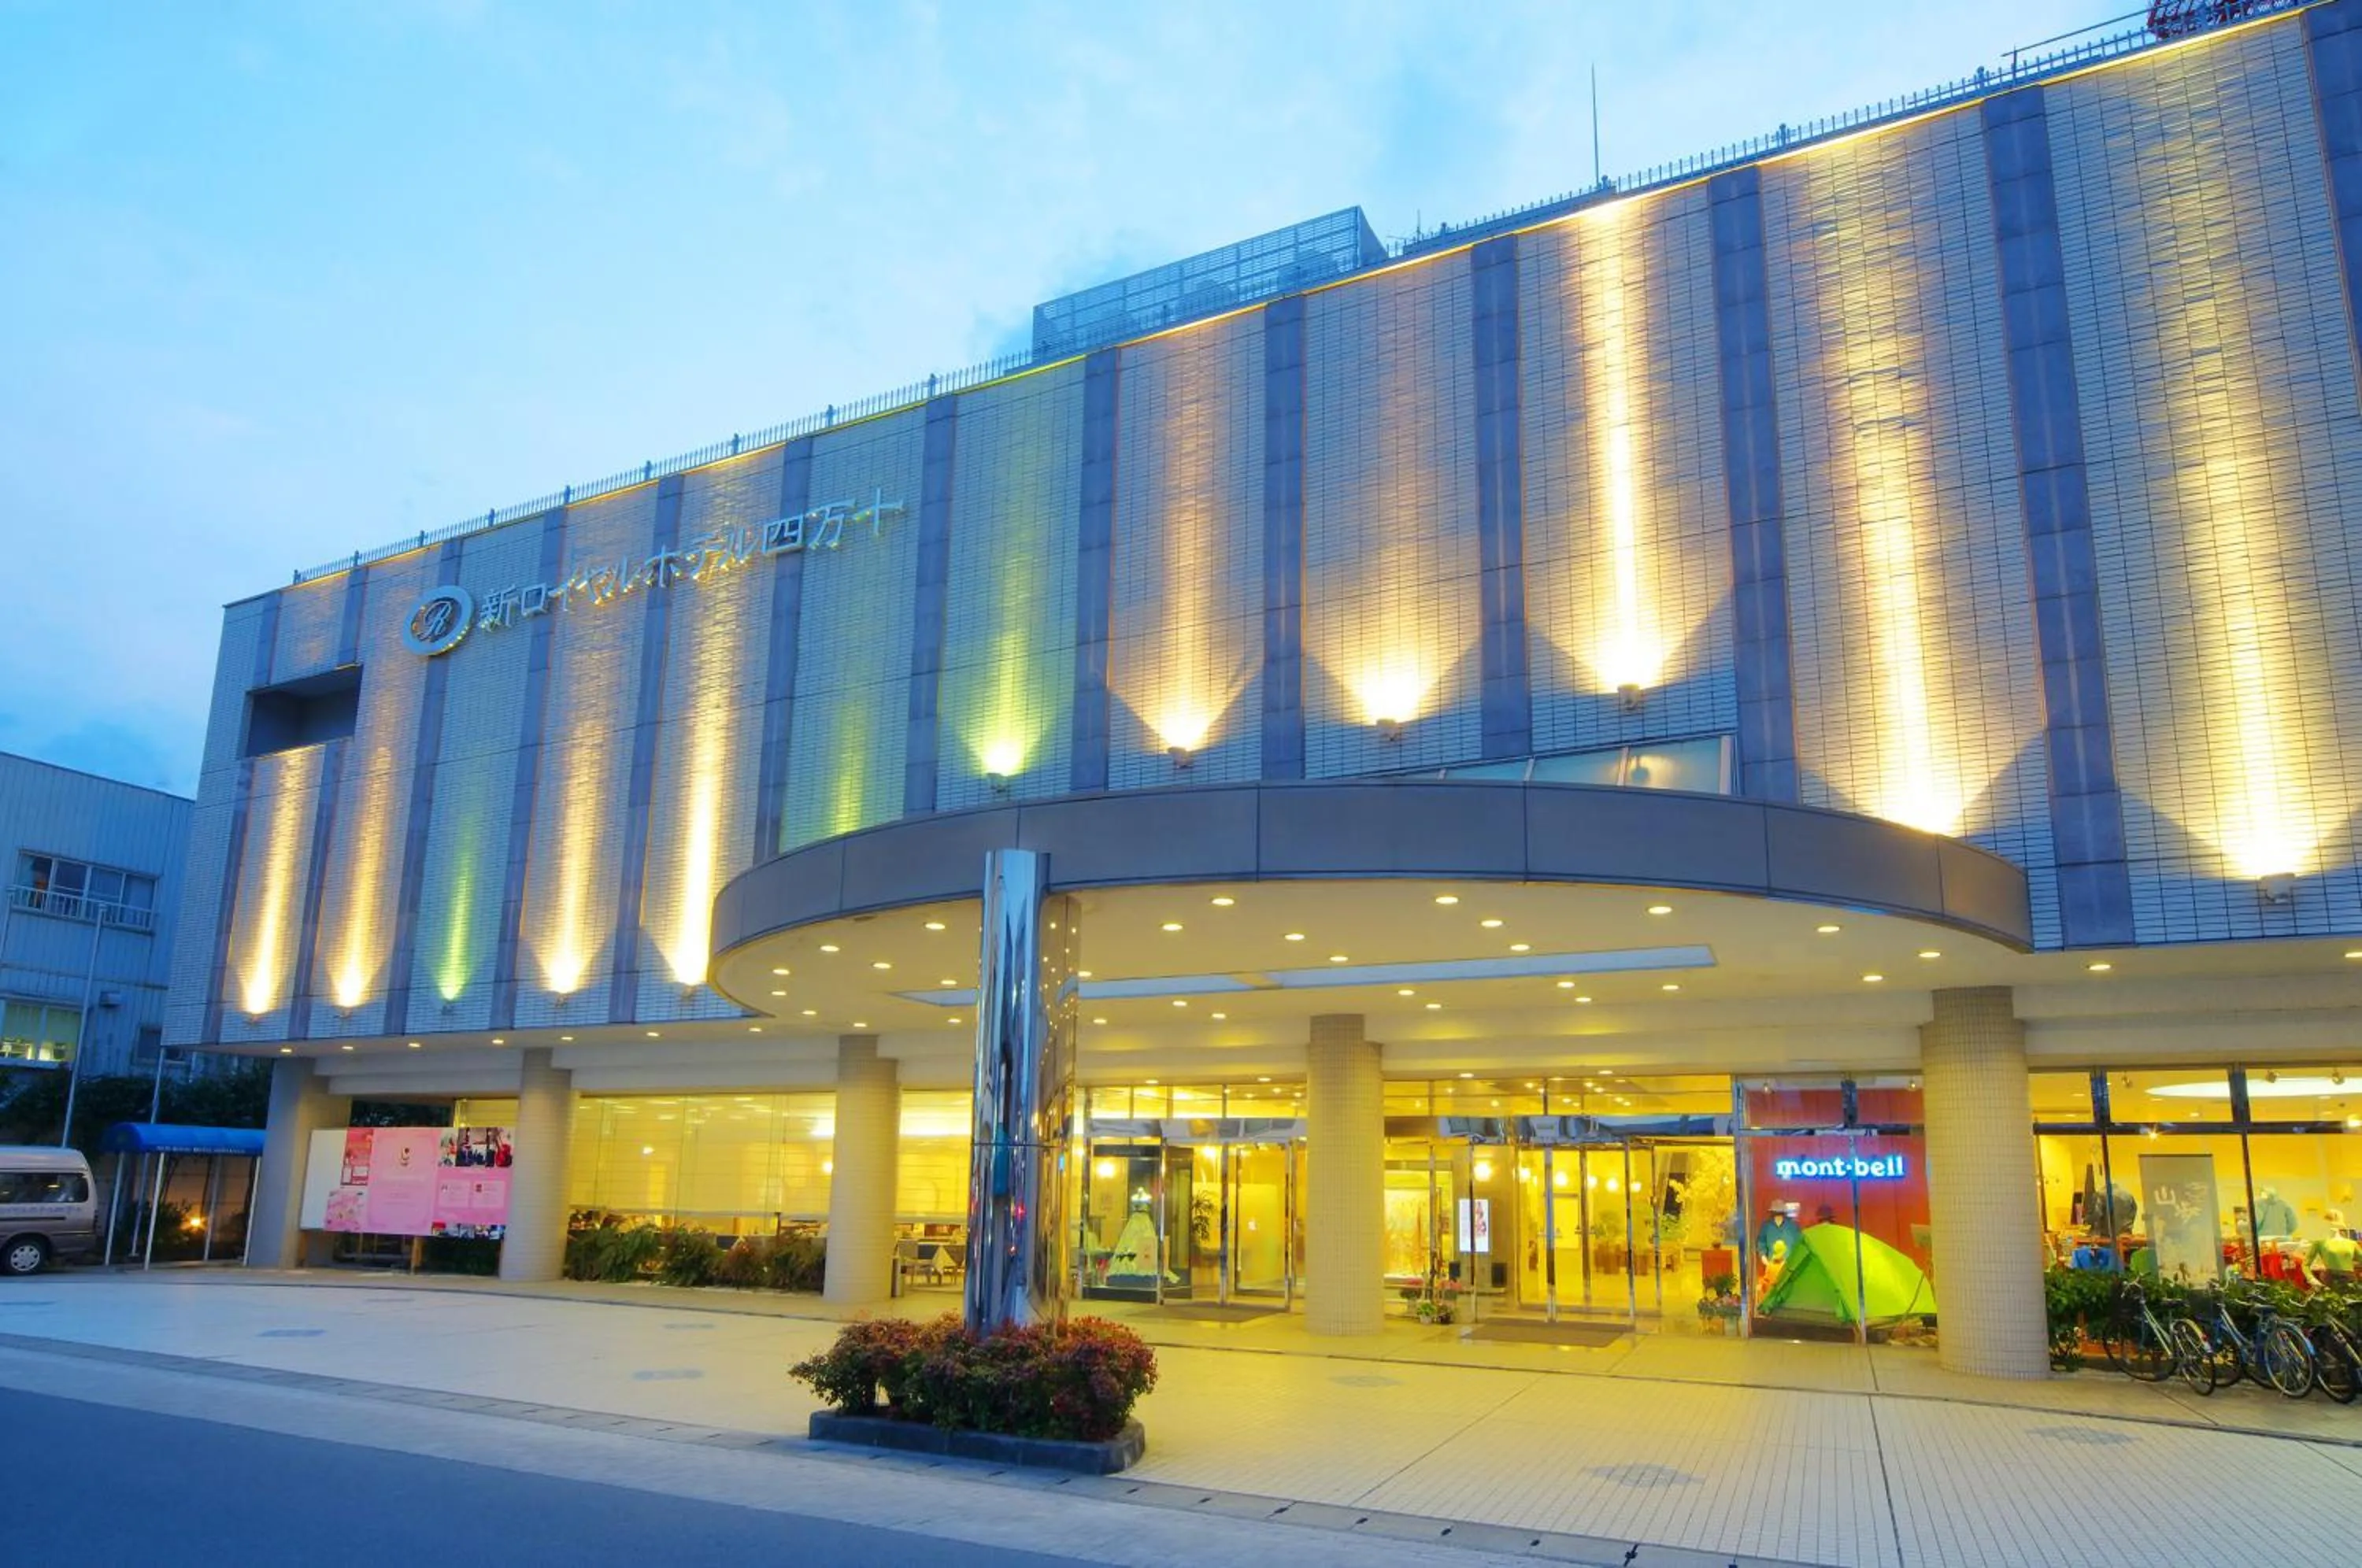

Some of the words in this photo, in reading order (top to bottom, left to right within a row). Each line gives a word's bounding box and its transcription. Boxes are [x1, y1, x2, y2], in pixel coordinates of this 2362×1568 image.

[478, 487, 904, 631] 新ロイヤルホテル四万十
